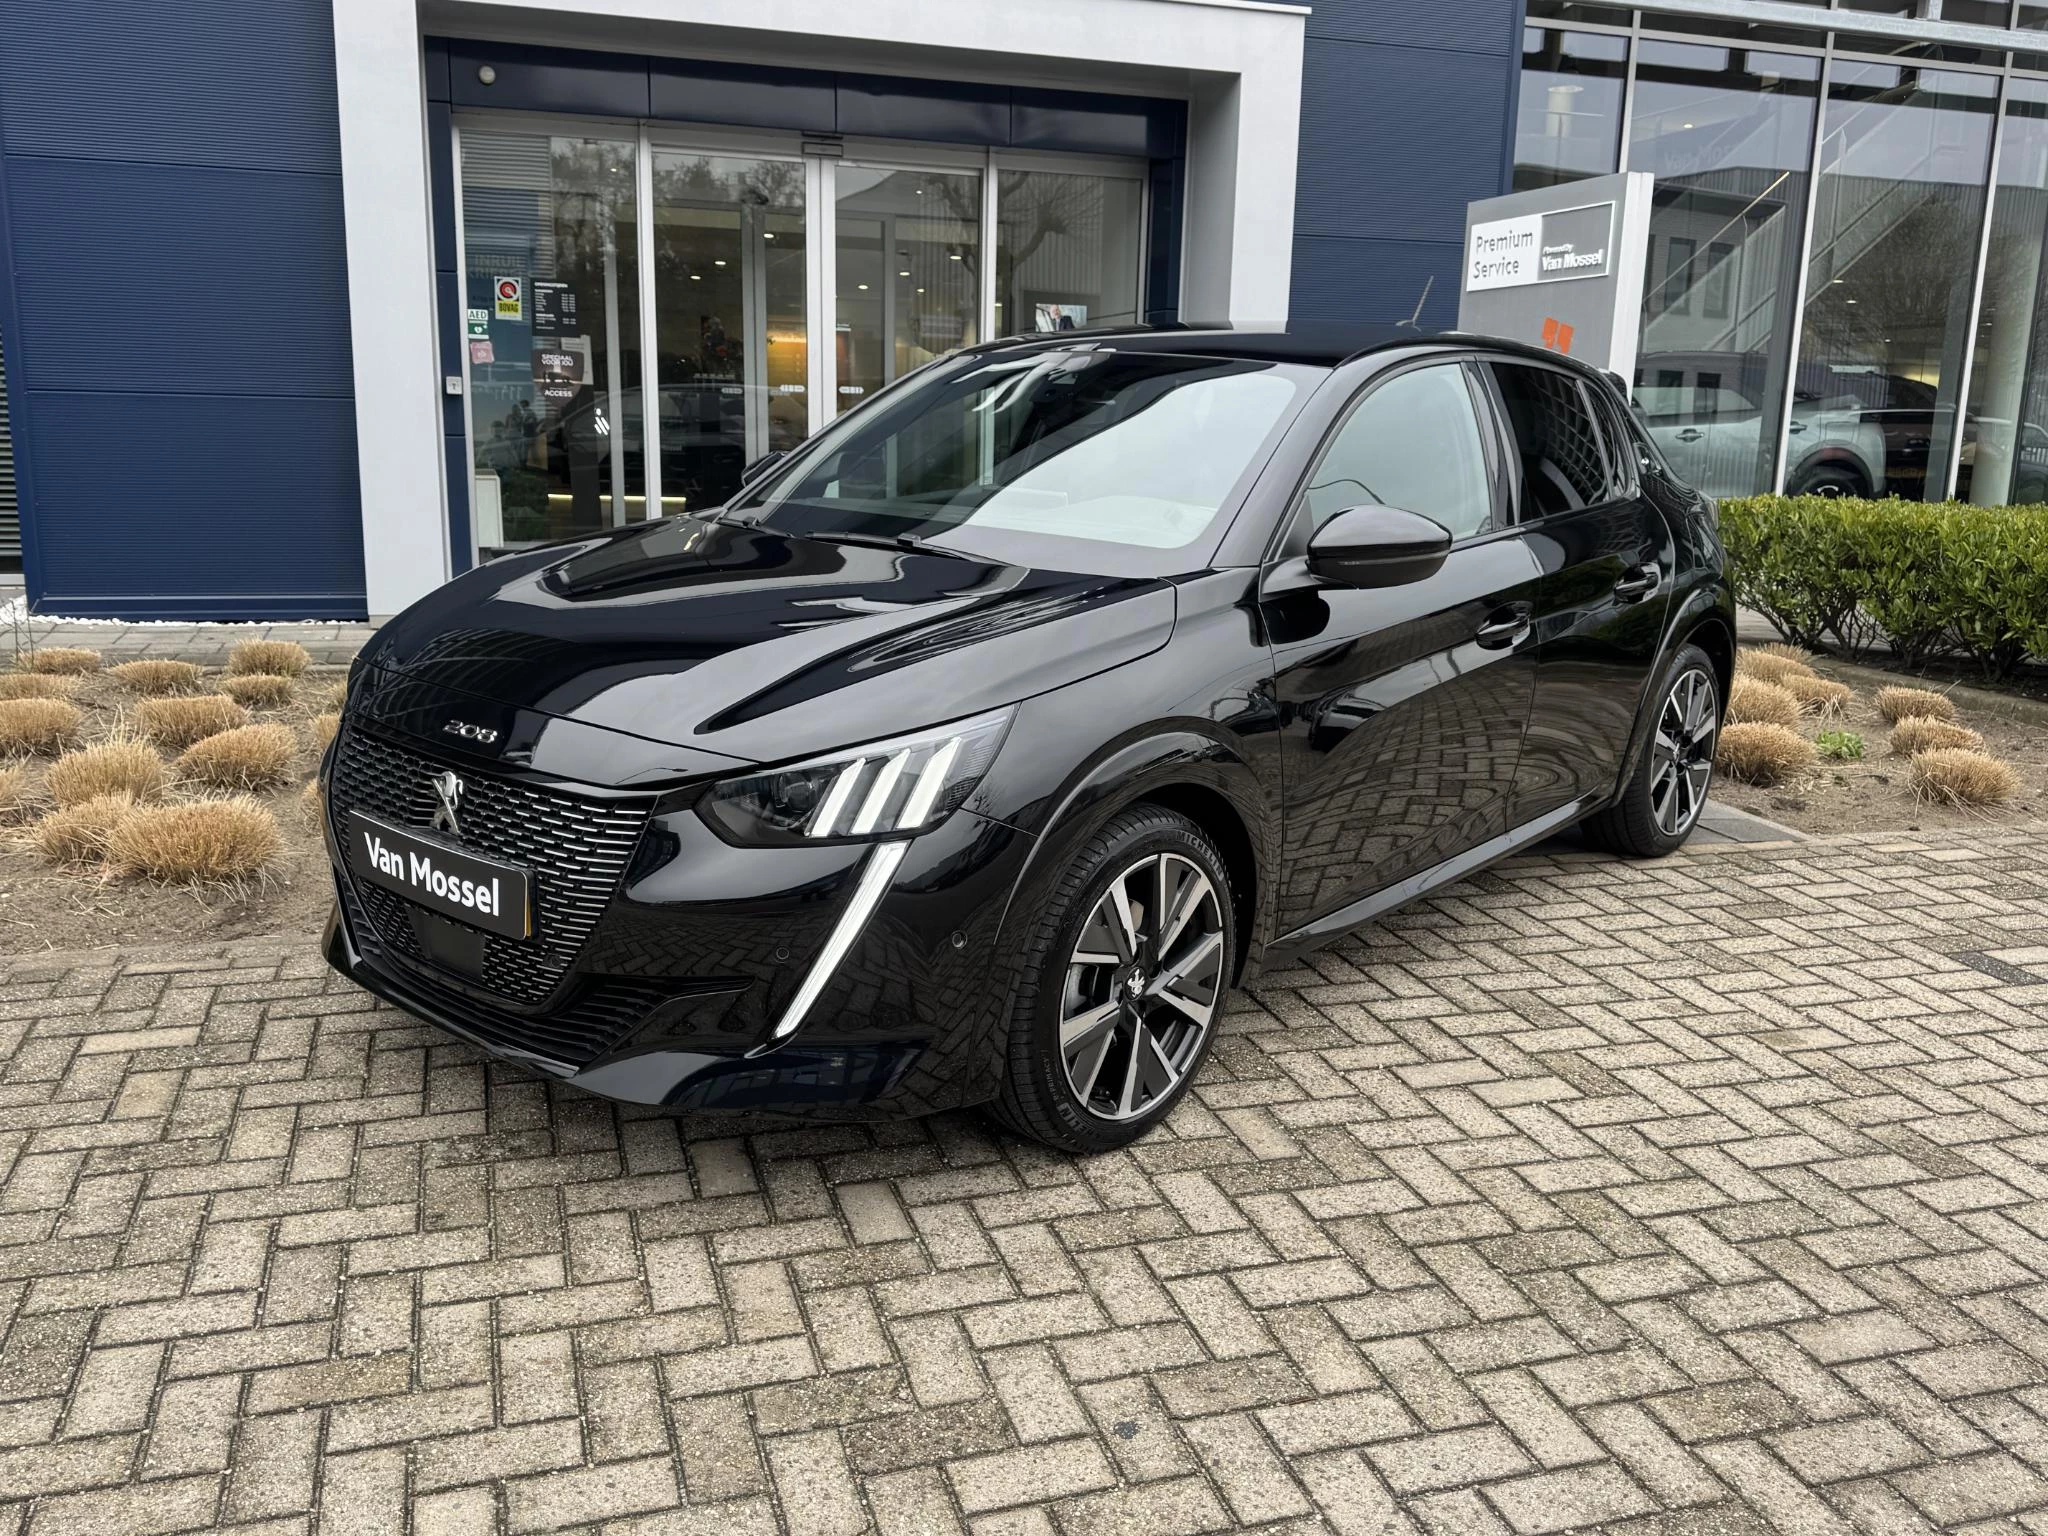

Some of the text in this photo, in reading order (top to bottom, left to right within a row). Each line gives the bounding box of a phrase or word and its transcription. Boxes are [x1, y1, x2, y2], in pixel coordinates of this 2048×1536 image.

[1476, 230, 1533, 254] Premium
[1473, 256, 1519, 279] Service
[1542, 249, 1604, 271] Van Mossel
[469, 310, 487, 319] AED
[498, 302, 519, 313] BOVAG
[443, 720, 498, 743] 208
[1175, 831, 1224, 881] MICHELIN
[364, 831, 499, 917] Van Mossel
